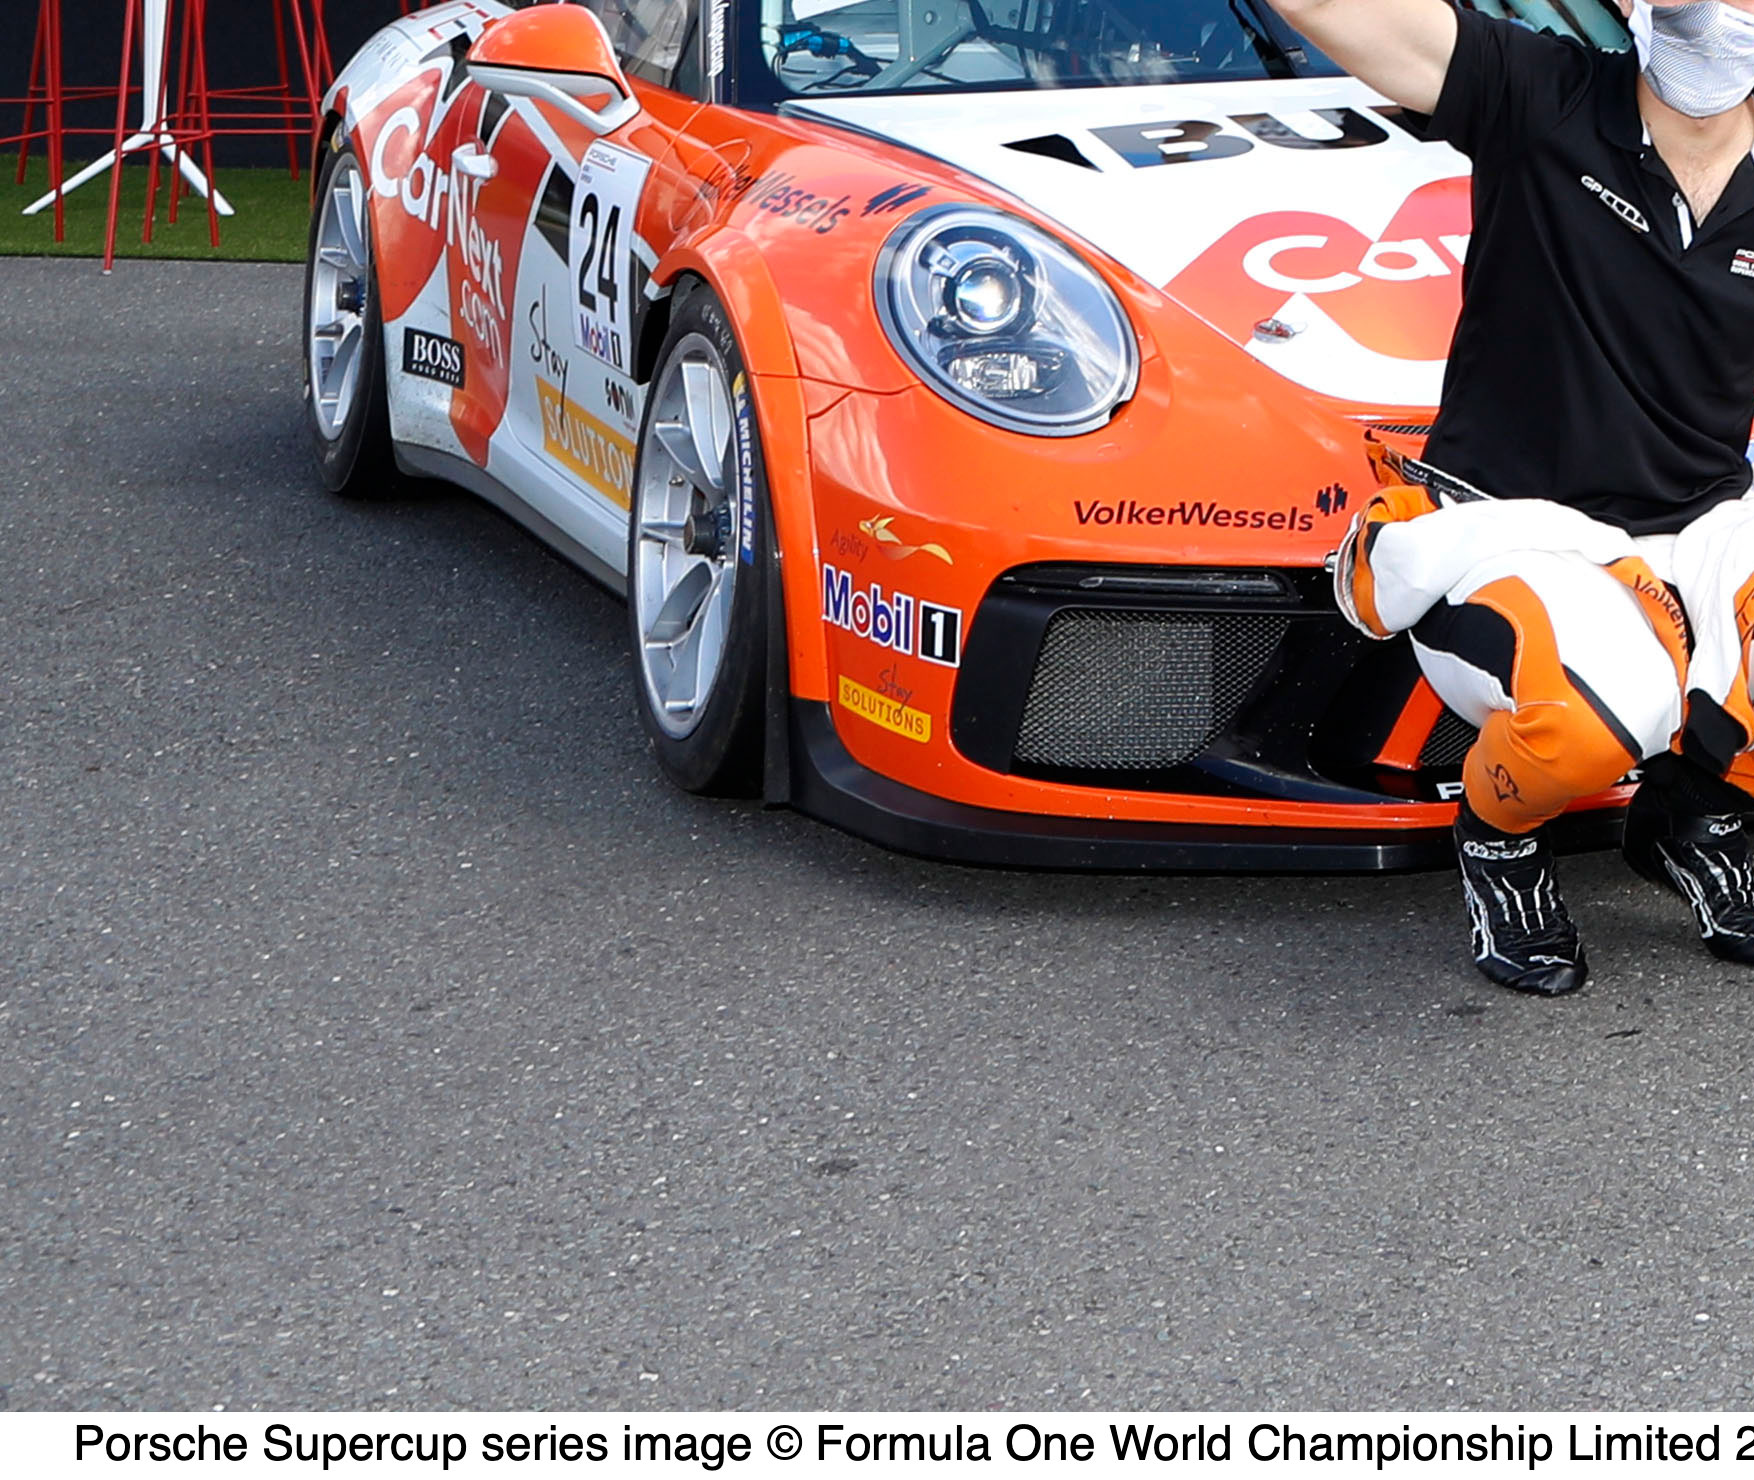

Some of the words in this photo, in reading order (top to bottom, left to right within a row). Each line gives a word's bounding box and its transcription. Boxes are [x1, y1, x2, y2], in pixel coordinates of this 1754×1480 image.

[577, 192, 620, 324] 24
[411, 333, 461, 374] BOSS
[580, 313, 612, 363] Mobil
[544, 394, 634, 498] SOLUTION
[1072, 499, 1314, 533] VolkerWessels
[821, 563, 914, 657] Mobil
[921, 607, 958, 663] 1
[842, 683, 927, 739] SOLUTIONS
